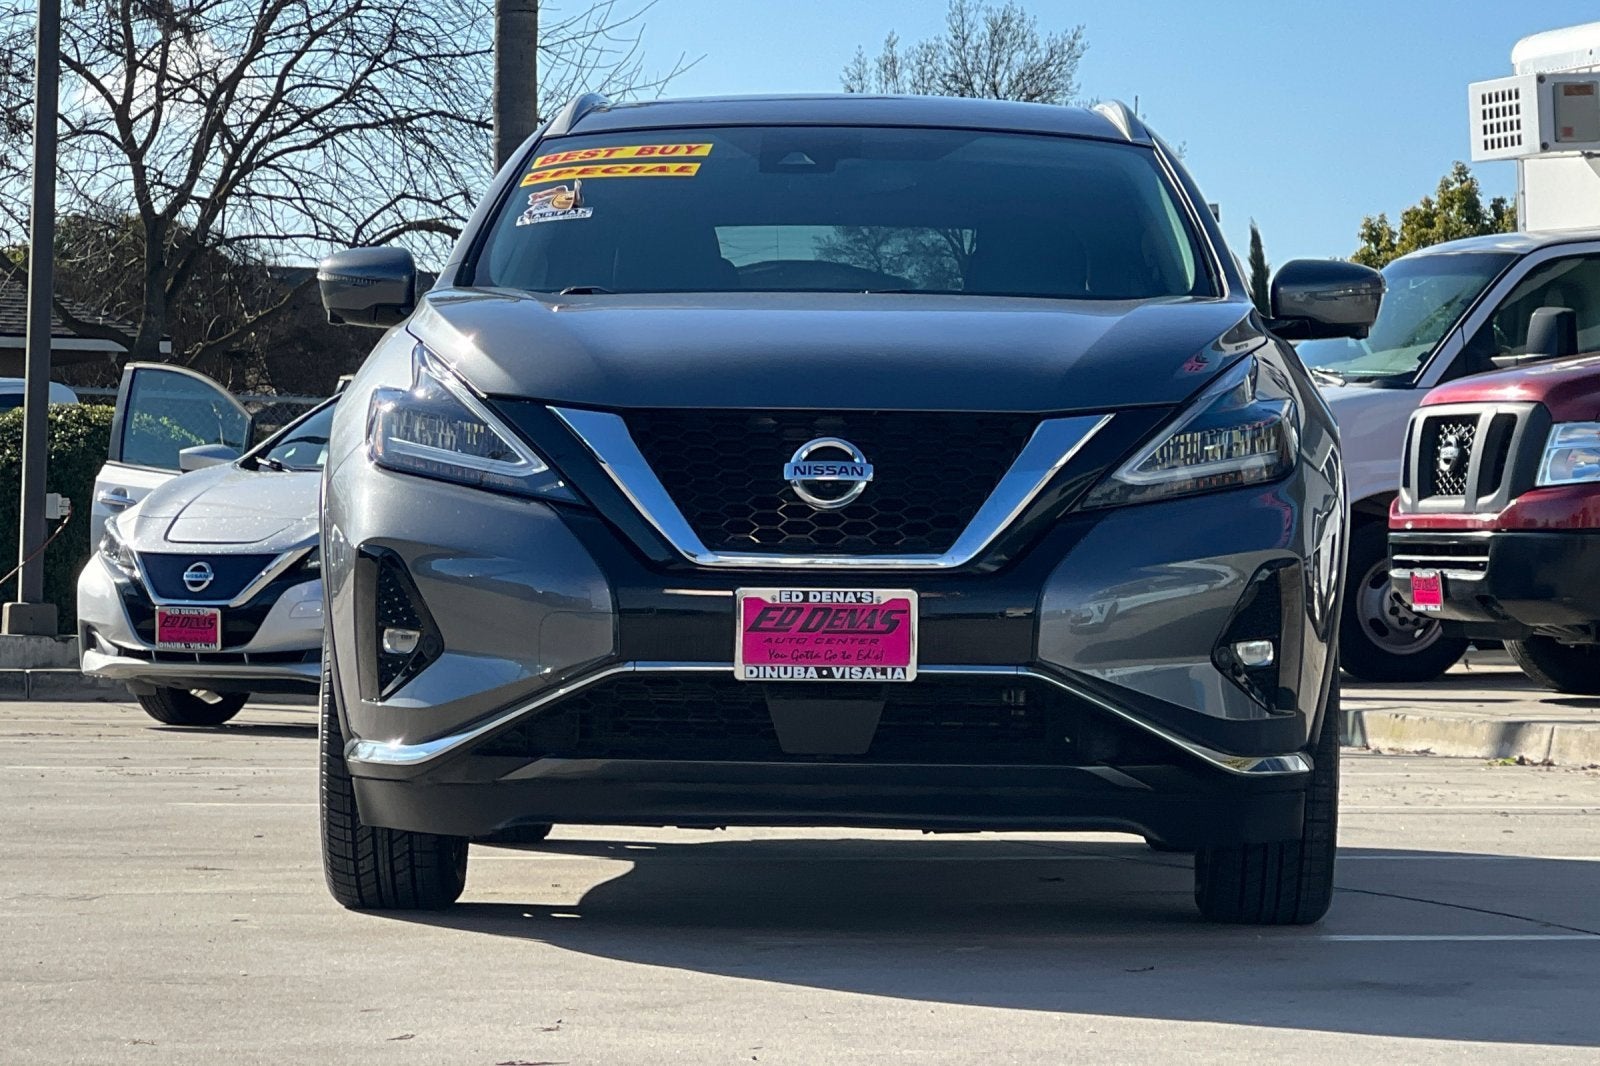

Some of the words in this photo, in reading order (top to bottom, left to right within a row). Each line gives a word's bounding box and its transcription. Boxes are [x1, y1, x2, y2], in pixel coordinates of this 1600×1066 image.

[538, 148, 624, 166] BEST
[634, 144, 704, 156] BUY
[525, 165, 693, 183] SPECIAL
[793, 465, 864, 476] NISSAN
[780, 591, 803, 603] ED
[809, 591, 872, 603] DENA'S
[746, 606, 804, 632] ED
[798, 607, 907, 634] DENA'S
[763, 637, 808, 645] AUTO
[815, 637, 880, 645] CENTER
[768, 649, 788, 660] You
[791, 649, 821, 660] Gotta
[824, 649, 838, 660] Go
[840, 650, 851, 659] to
[745, 667, 819, 679] DINUBA
[831, 667, 906, 680] VISALIA
